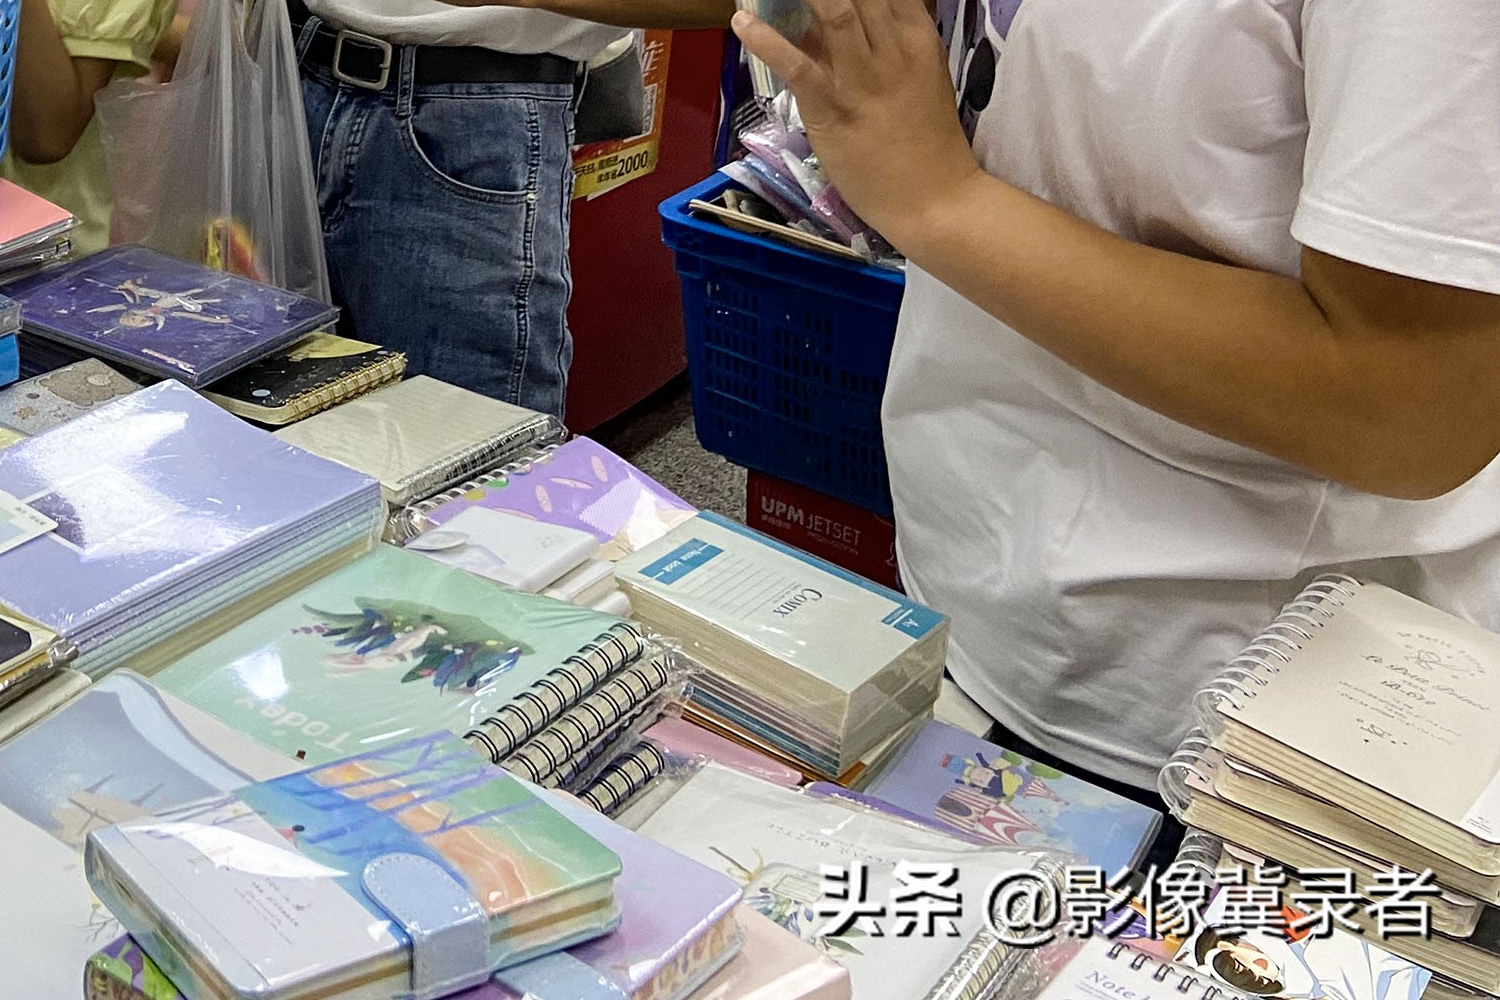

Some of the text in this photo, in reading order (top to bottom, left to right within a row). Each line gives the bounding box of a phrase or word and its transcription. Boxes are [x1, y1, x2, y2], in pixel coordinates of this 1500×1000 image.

[617, 151, 649, 178] 2000
[761, 496, 804, 526] UPM
[805, 514, 861, 546] JETSET
[233, 696, 352, 755] Today
